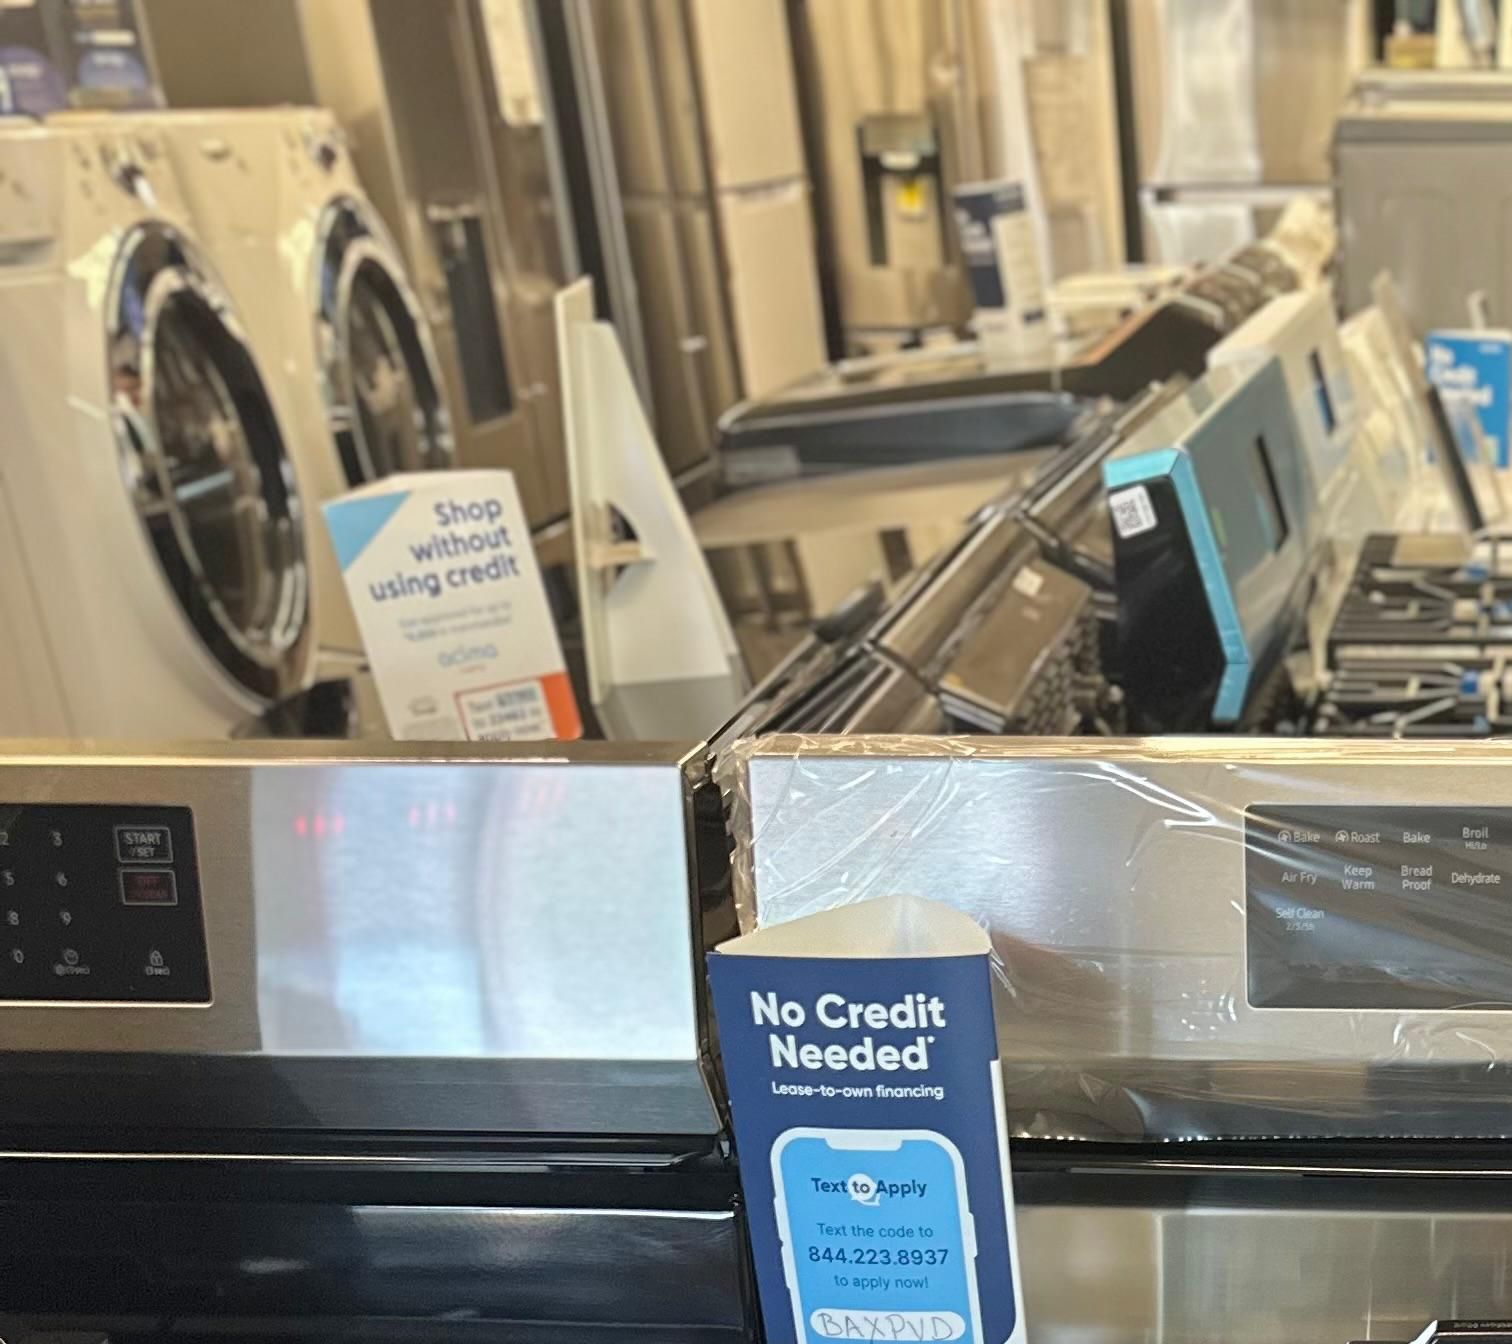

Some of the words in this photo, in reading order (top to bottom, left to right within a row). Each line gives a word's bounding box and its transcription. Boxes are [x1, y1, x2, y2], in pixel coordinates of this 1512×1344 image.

[433, 498, 502, 527] Shop
[410, 527, 511, 563] without
[369, 572, 442, 602] using
[445, 554, 520, 588] credit
[123, 831, 162, 845] START
[1293, 831, 1320, 843] Bake
[1350, 831, 1380, 844] Roast
[1402, 831, 1431, 844] Bake
[1462, 827, 1489, 839] Broil
[1281, 871, 1297, 884] Air
[1300, 871, 1317, 887] Fry
[1343, 865, 1373, 880] Keep
[1400, 865, 1433, 878] Bread
[1451, 872, 1501, 887] Dehydrate
[1341, 879, 1375, 891] Warm
[1401, 879, 1432, 891] Proof
[1275, 907, 1294, 920] Self
[1296, 907, 1325, 920] Clean
[750, 991, 806, 1027] No
[815, 992, 946, 1029] Credit
[771, 1081, 873, 1098] Lease-to-own
[875, 1084, 944, 1101] financing
[811, 1177, 848, 1194] Text
[852, 1180, 870, 1195] to
[875, 1179, 927, 1198] Apply
[816, 1223, 848, 1237] Text
[851, 1225, 875, 1238] the
[878, 1225, 915, 1239] code
[918, 1226, 934, 1239] to
[808, 1246, 949, 1266] 844.223.8937
[834, 1275, 849, 1288] to
[852, 1276, 890, 1291] apply
[895, 1275, 929, 1289] now!
[817, 1312, 953, 1344] BAXPVD
